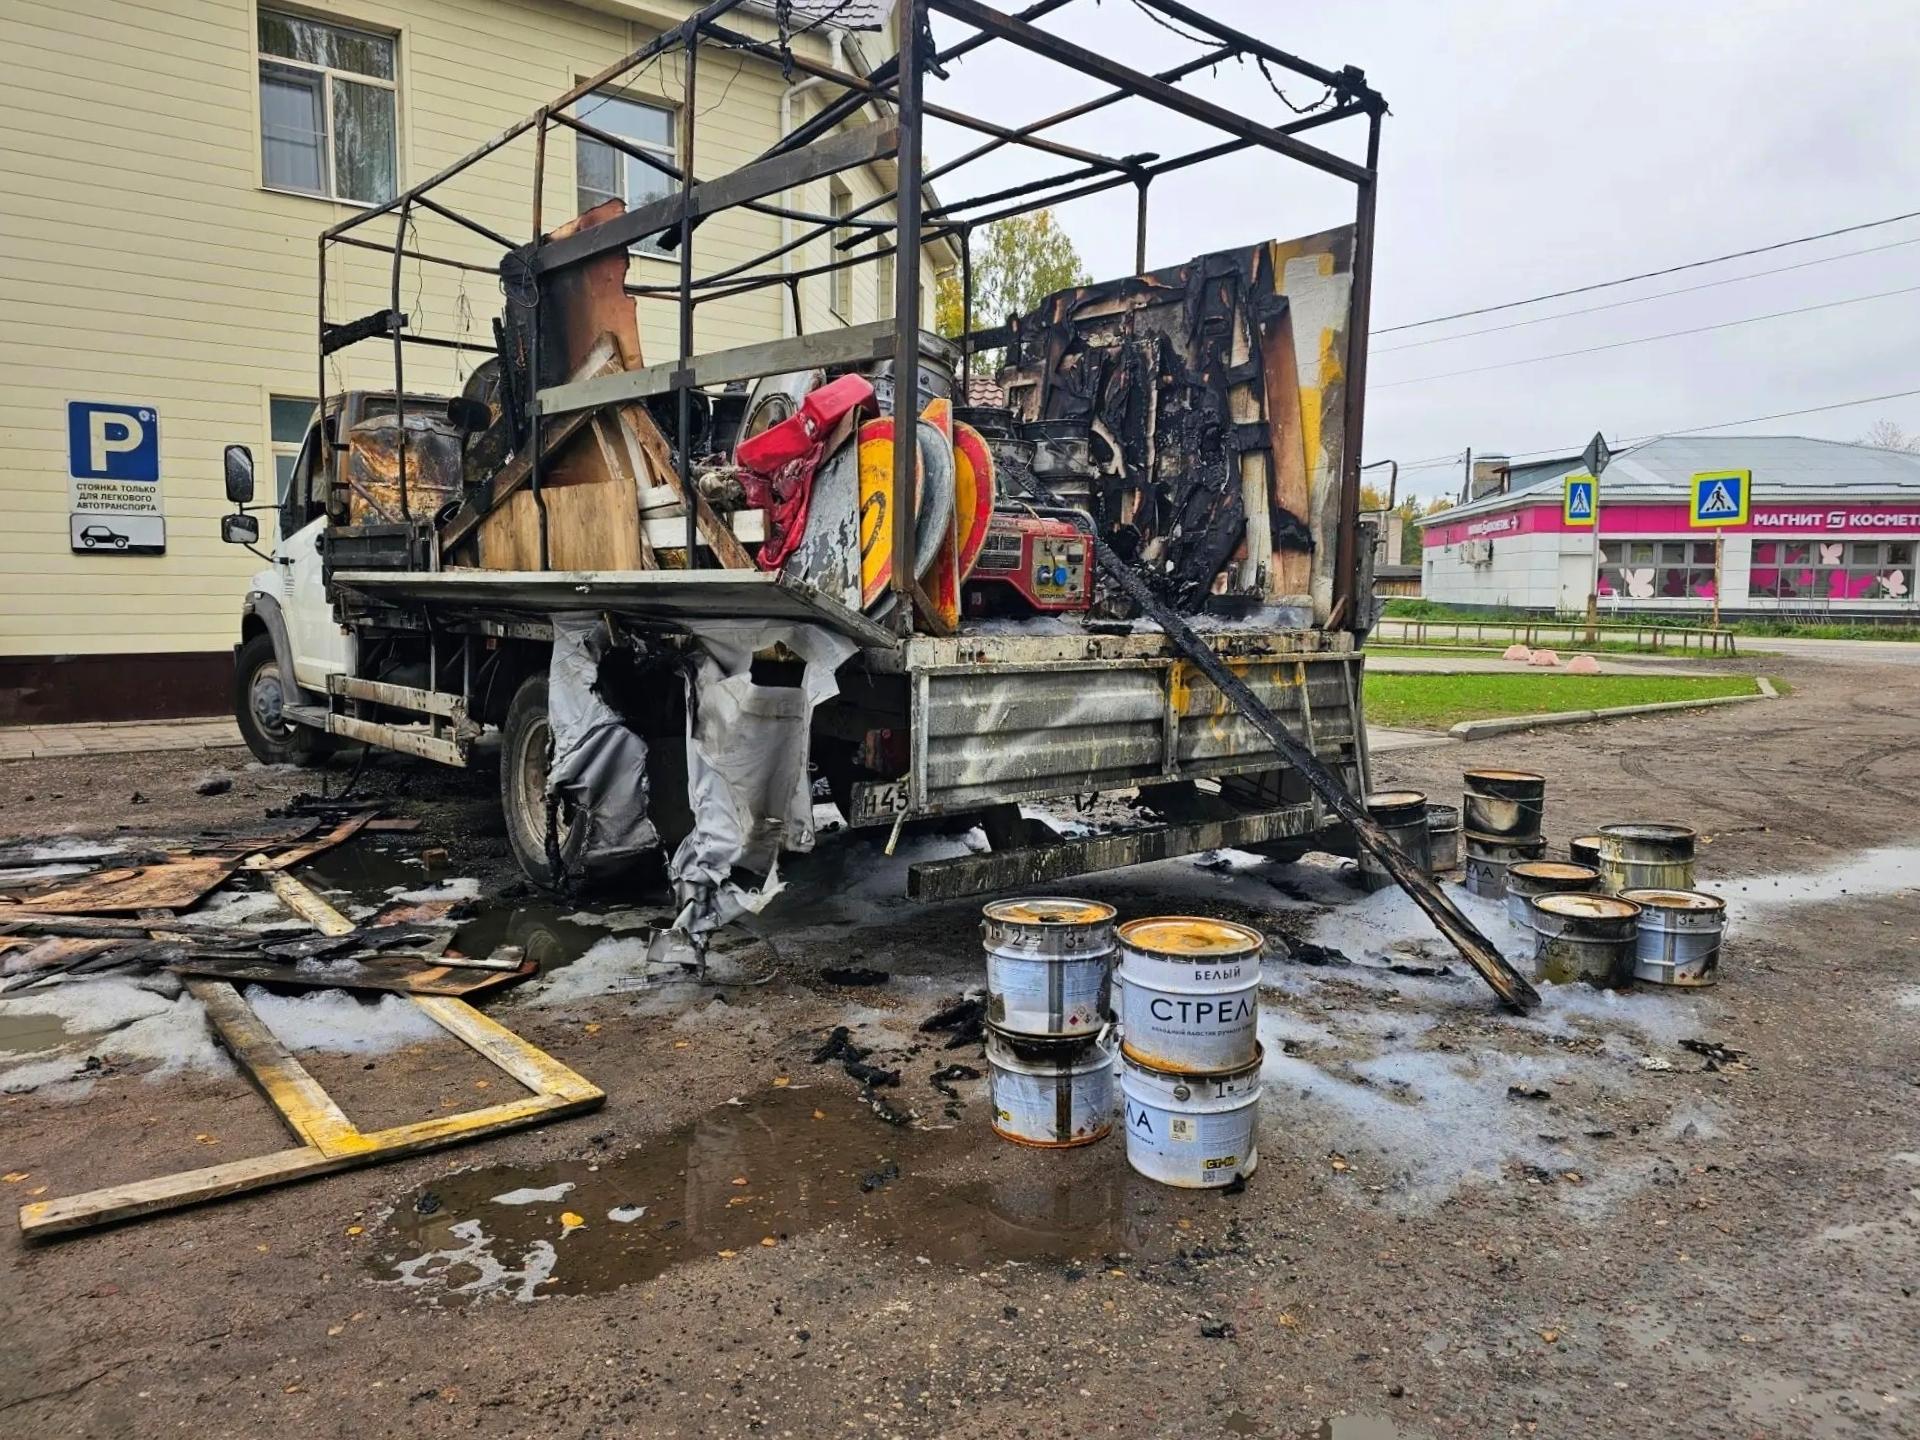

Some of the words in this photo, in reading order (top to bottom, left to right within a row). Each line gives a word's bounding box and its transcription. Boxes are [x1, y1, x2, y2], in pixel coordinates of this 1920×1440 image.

[89, 411, 144, 471] P
[76, 483, 117, 492] СТОЯНКА
[121, 485, 156, 493] ТОЛЬКО
[78, 492, 98, 501] ДЛЯ
[100, 494, 152, 502] ЛЕГКОВОГО
[76, 502, 157, 511] АВТОТРАНСПОРТА
[1753, 513, 1823, 526] МАГНИТ
[1849, 513, 1920, 526] КОСМЕТ
[1195, 966, 1241, 981] БЕЛЫЙ
